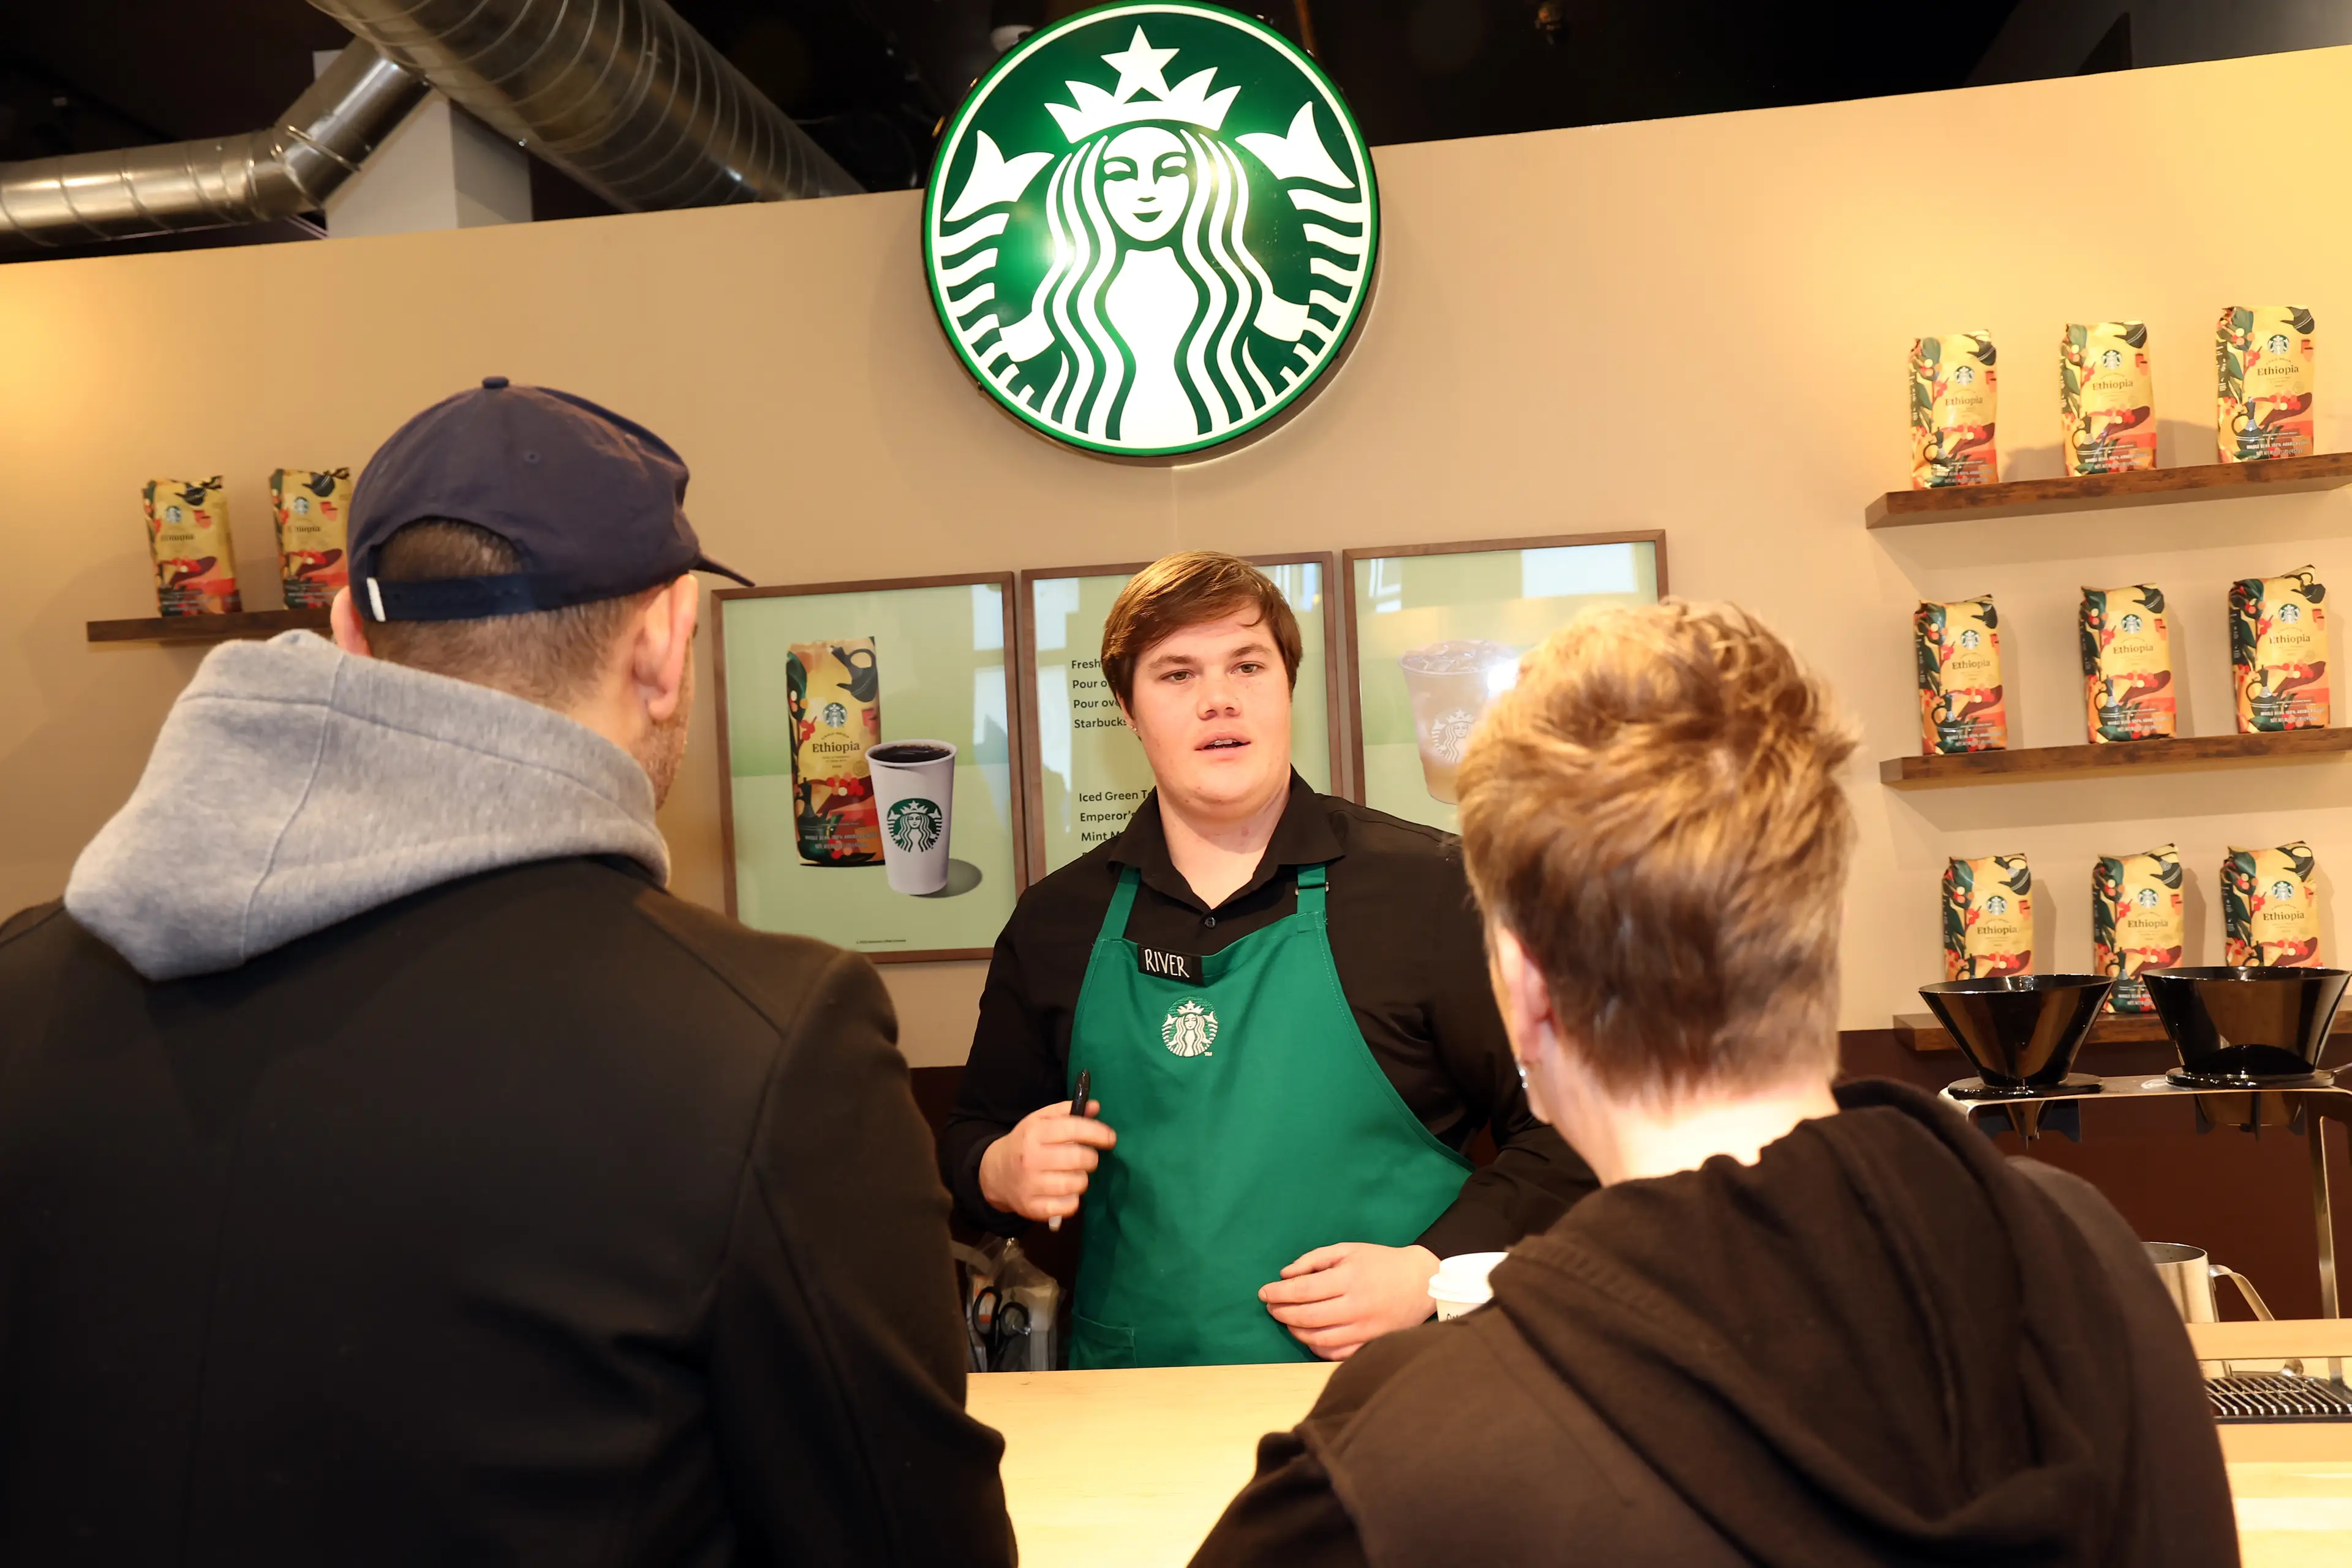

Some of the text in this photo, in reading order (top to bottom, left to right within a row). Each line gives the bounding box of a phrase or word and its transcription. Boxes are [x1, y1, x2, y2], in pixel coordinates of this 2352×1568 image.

[2258, 364, 2299, 376] Ethiopia
[2092, 379, 2133, 390] Ethiopia
[1945, 396, 1983, 406] Ethiopia
[2269, 633, 2310, 644] Ethiopia
[2113, 643, 2154, 654] Ethiopia
[1071, 658, 1101, 669] Fresh
[1951, 659, 1991, 670] Ethiopia
[1072, 680, 1098, 688] Pour
[1074, 699, 1098, 709] Pour
[1074, 717, 1127, 728] Starbucks
[812, 741, 860, 754] Ethiopia
[1079, 792, 1102, 802] Iced
[1105, 791, 1138, 801] Green
[1081, 832, 1107, 842] Mint
[2263, 911, 2305, 921] Ethiopia
[2128, 919, 2168, 929] Ethiopia
[1977, 925, 2018, 935] Ethiopia
[1144, 949, 1190, 978] RIVER
